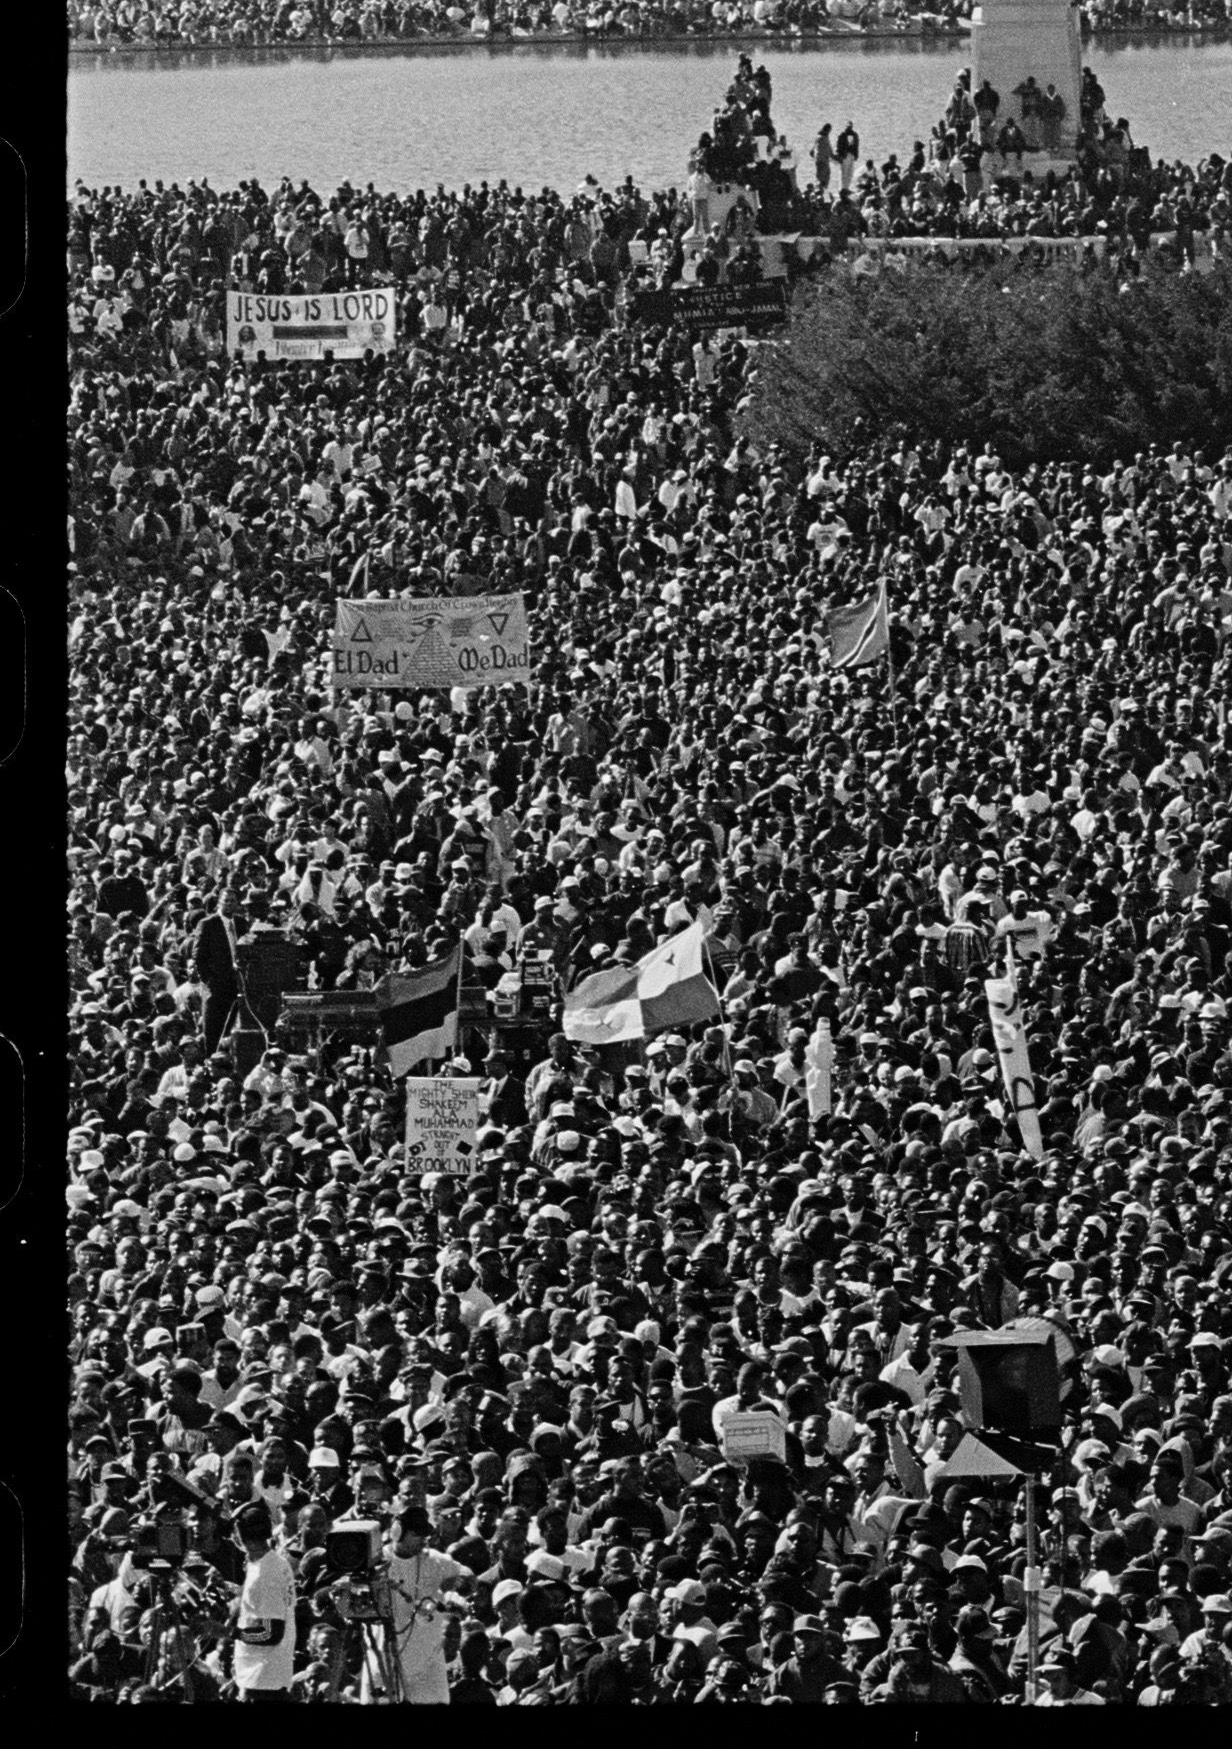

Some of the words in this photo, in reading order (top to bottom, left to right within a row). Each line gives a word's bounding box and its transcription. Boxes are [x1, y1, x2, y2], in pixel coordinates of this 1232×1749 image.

[689, 292, 743, 303] JUSTICE
[234, 295, 292, 323] JESUS
[304, 299, 322, 322] IS
[333, 293, 389, 321] LORD
[334, 649, 352, 674] El
[356, 649, 399, 675] Dad
[490, 643, 528, 670] Dad
[433, 1080, 453, 1090] THE
[414, 1118, 475, 1129] MUHAMMAD
[408, 1156, 472, 1174] BROOKLYN
